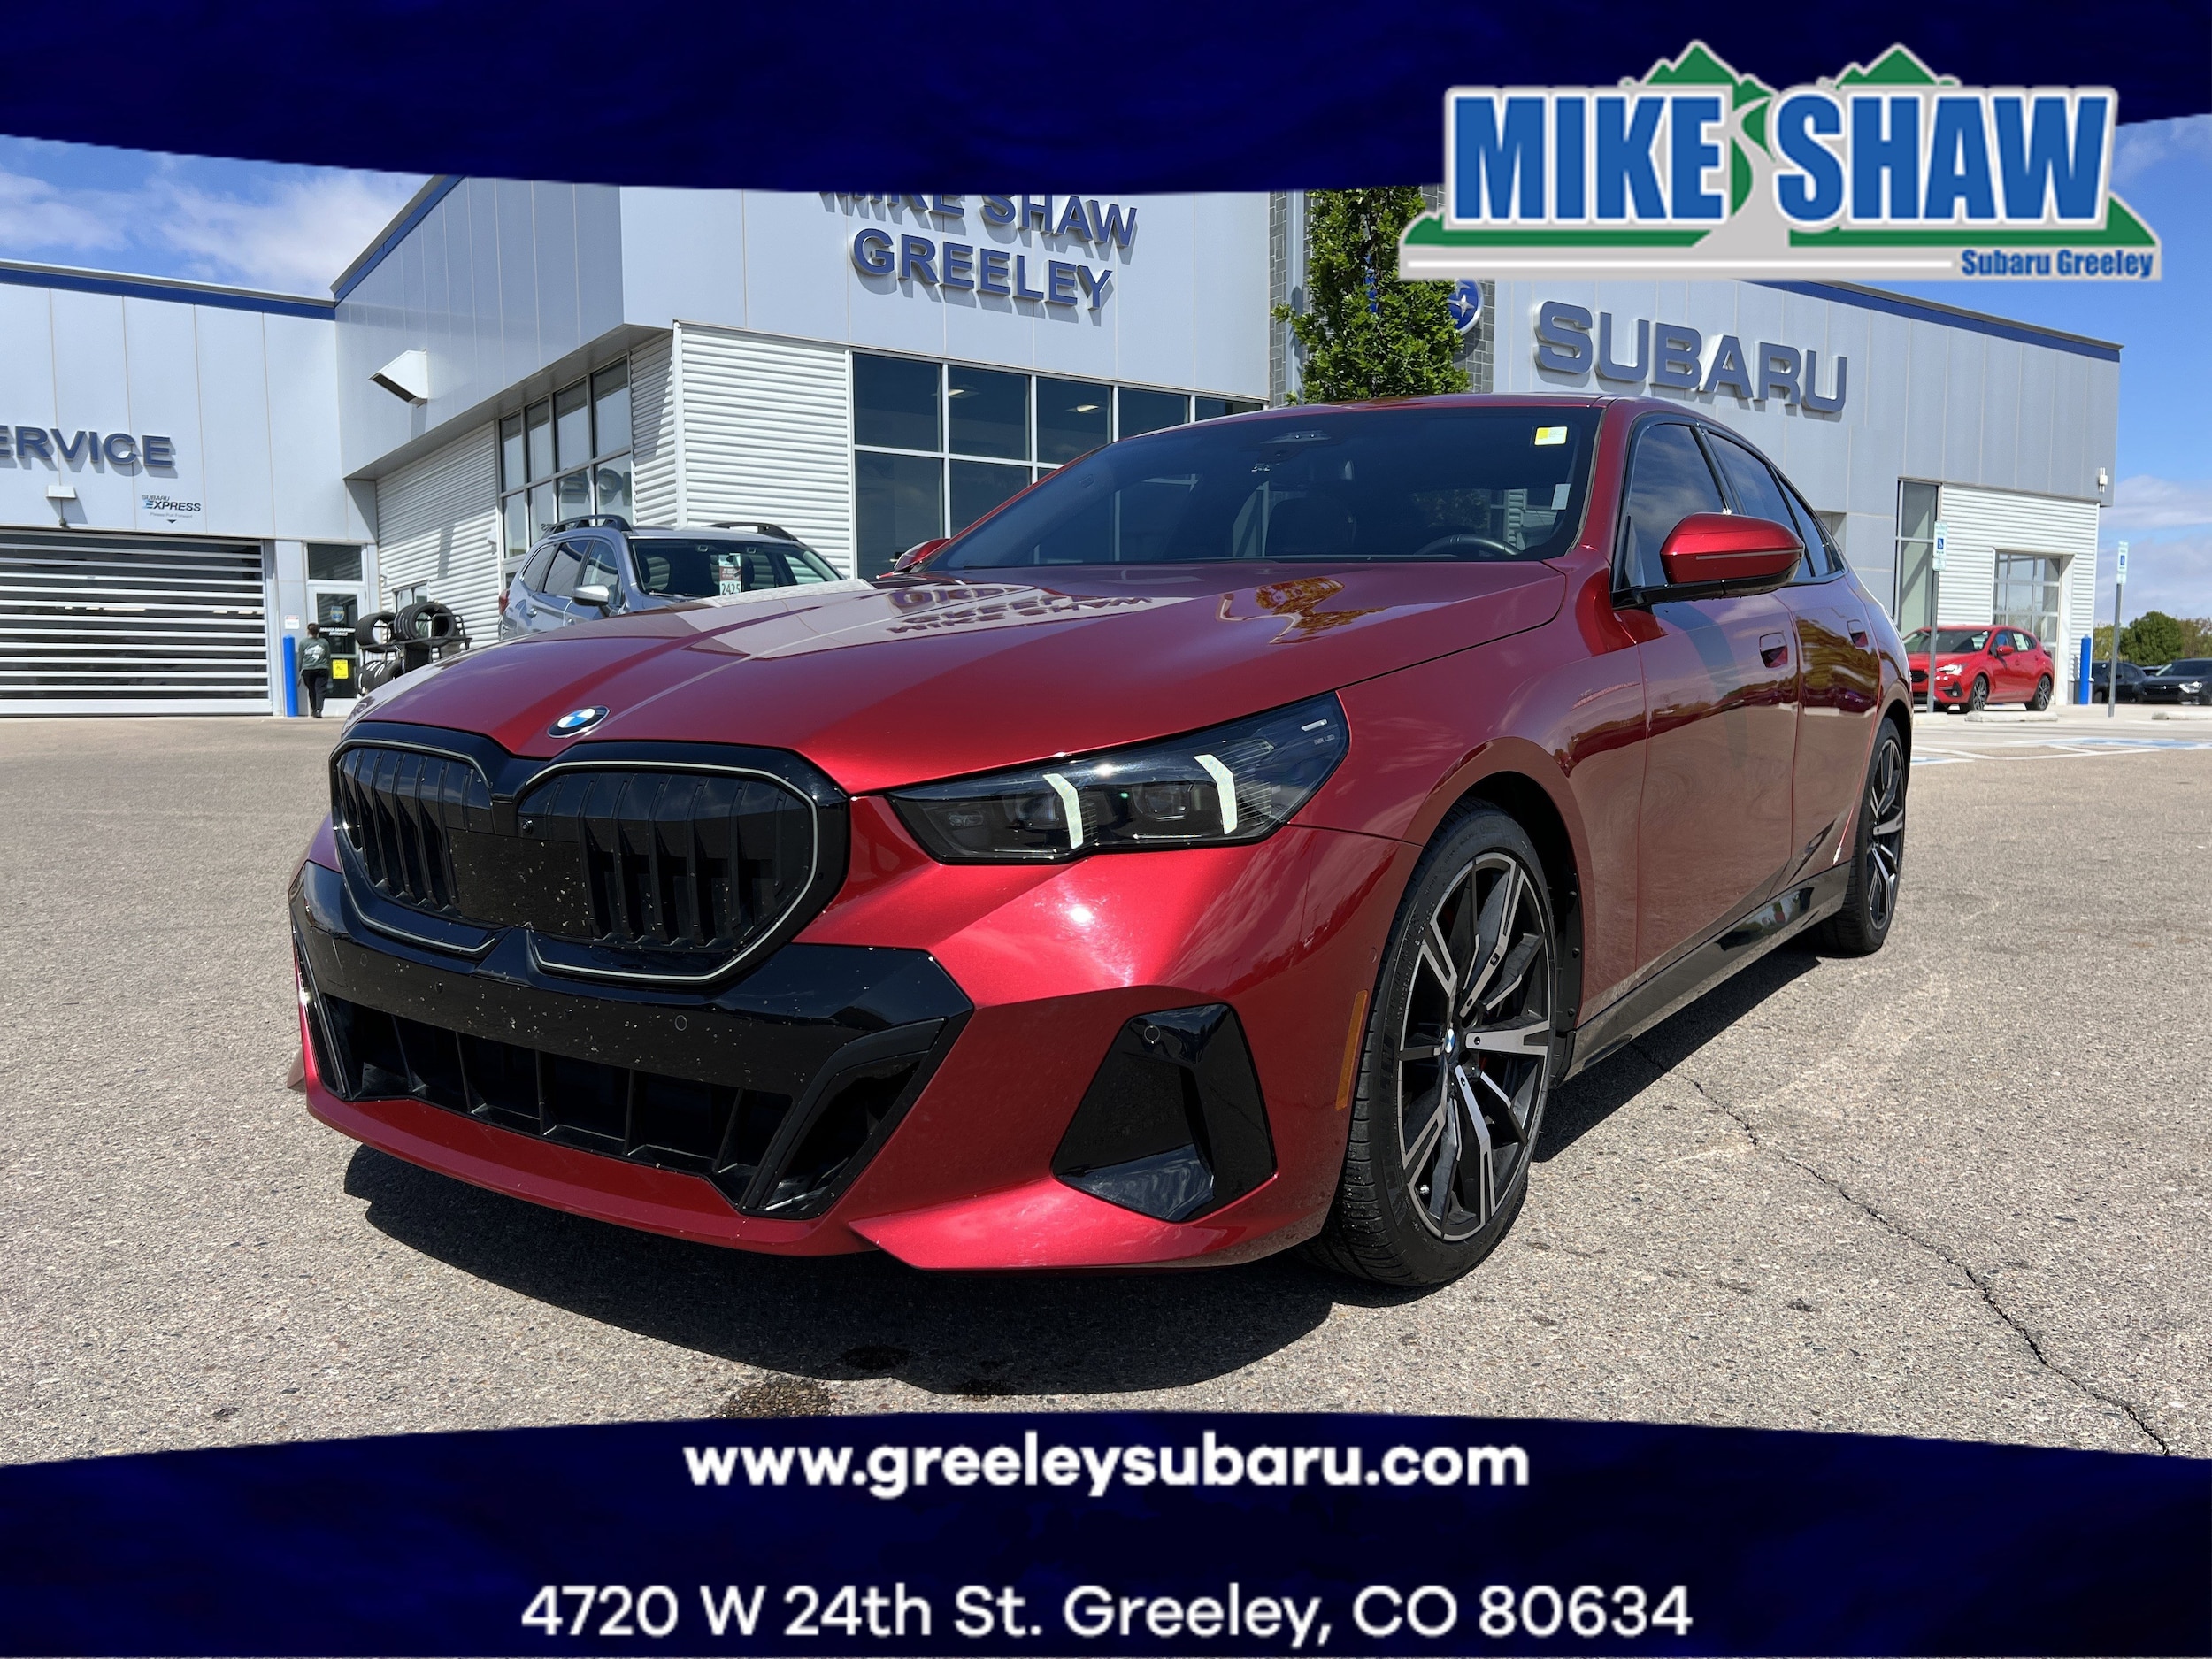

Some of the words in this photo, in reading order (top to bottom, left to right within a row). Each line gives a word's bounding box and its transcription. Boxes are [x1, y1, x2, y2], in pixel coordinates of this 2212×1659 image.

[980, 194, 1138, 249] SHAW
[850, 228, 1113, 310] GREELEY
[1534, 300, 1847, 412] SUBARU
[143, 500, 202, 511] EXPRESS
